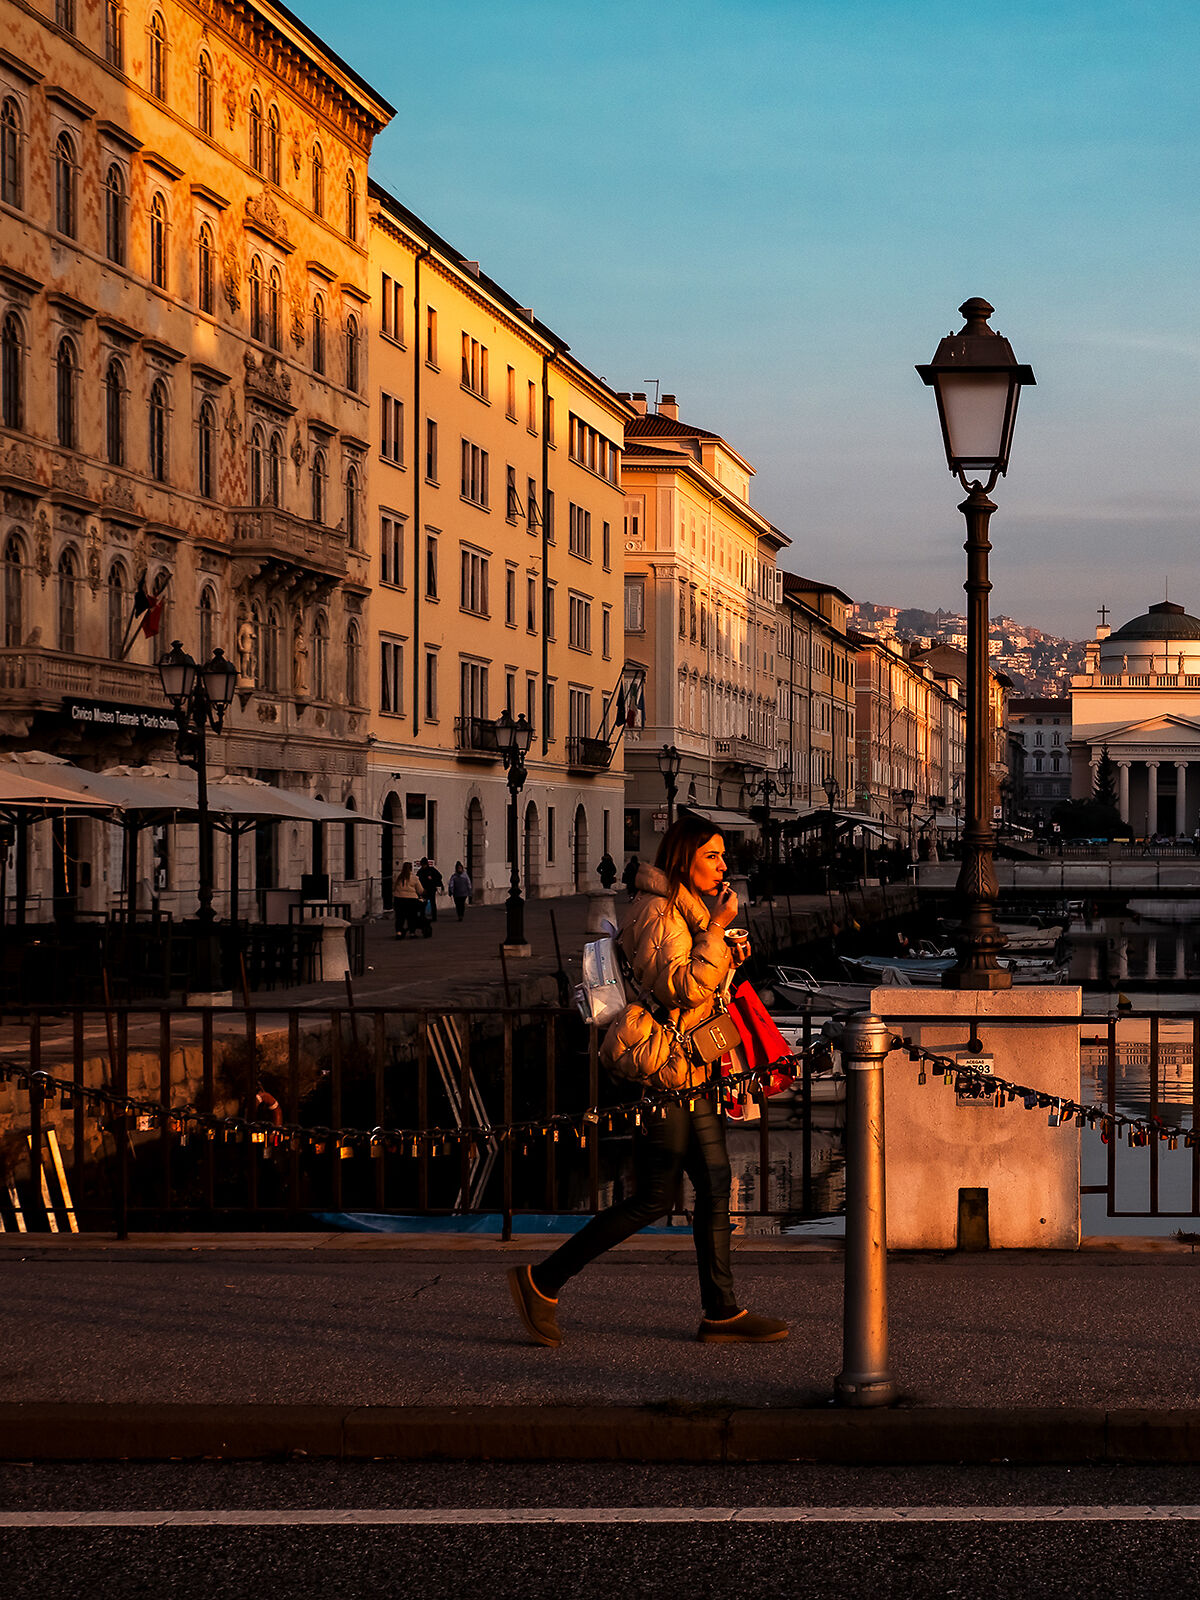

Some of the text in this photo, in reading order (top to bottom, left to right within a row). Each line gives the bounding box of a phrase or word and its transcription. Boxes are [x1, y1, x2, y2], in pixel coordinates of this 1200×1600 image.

[72, 705, 93, 721] Civico
[94, 707, 115, 724] Museo
[115, 710, 140, 726] Teatrale
